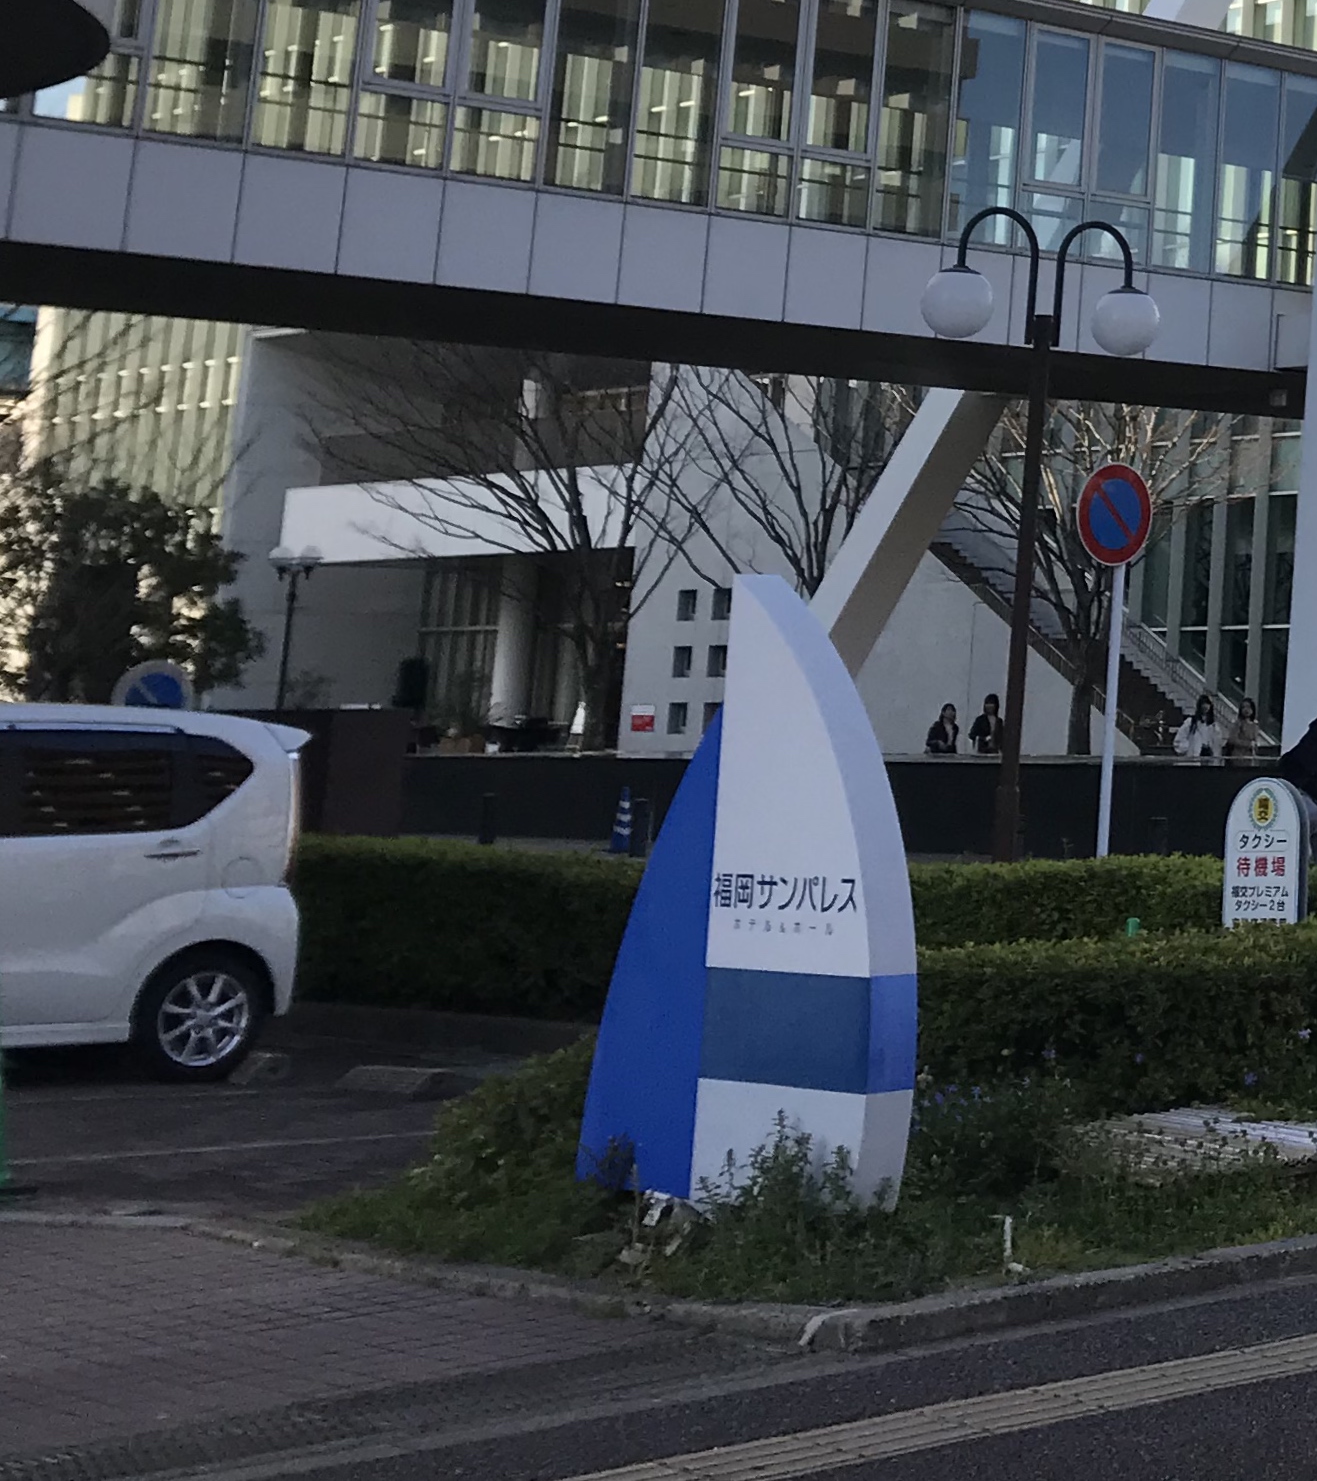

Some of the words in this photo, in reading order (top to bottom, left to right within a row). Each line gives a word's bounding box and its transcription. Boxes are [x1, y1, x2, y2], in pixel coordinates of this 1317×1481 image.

[1239, 834, 1287, 849] タクシー
[1236, 856, 1285, 877] 待機場
[714, 873, 857, 913] 福岡サンパレス
[1235, 899, 1285, 912] タクシー2台
